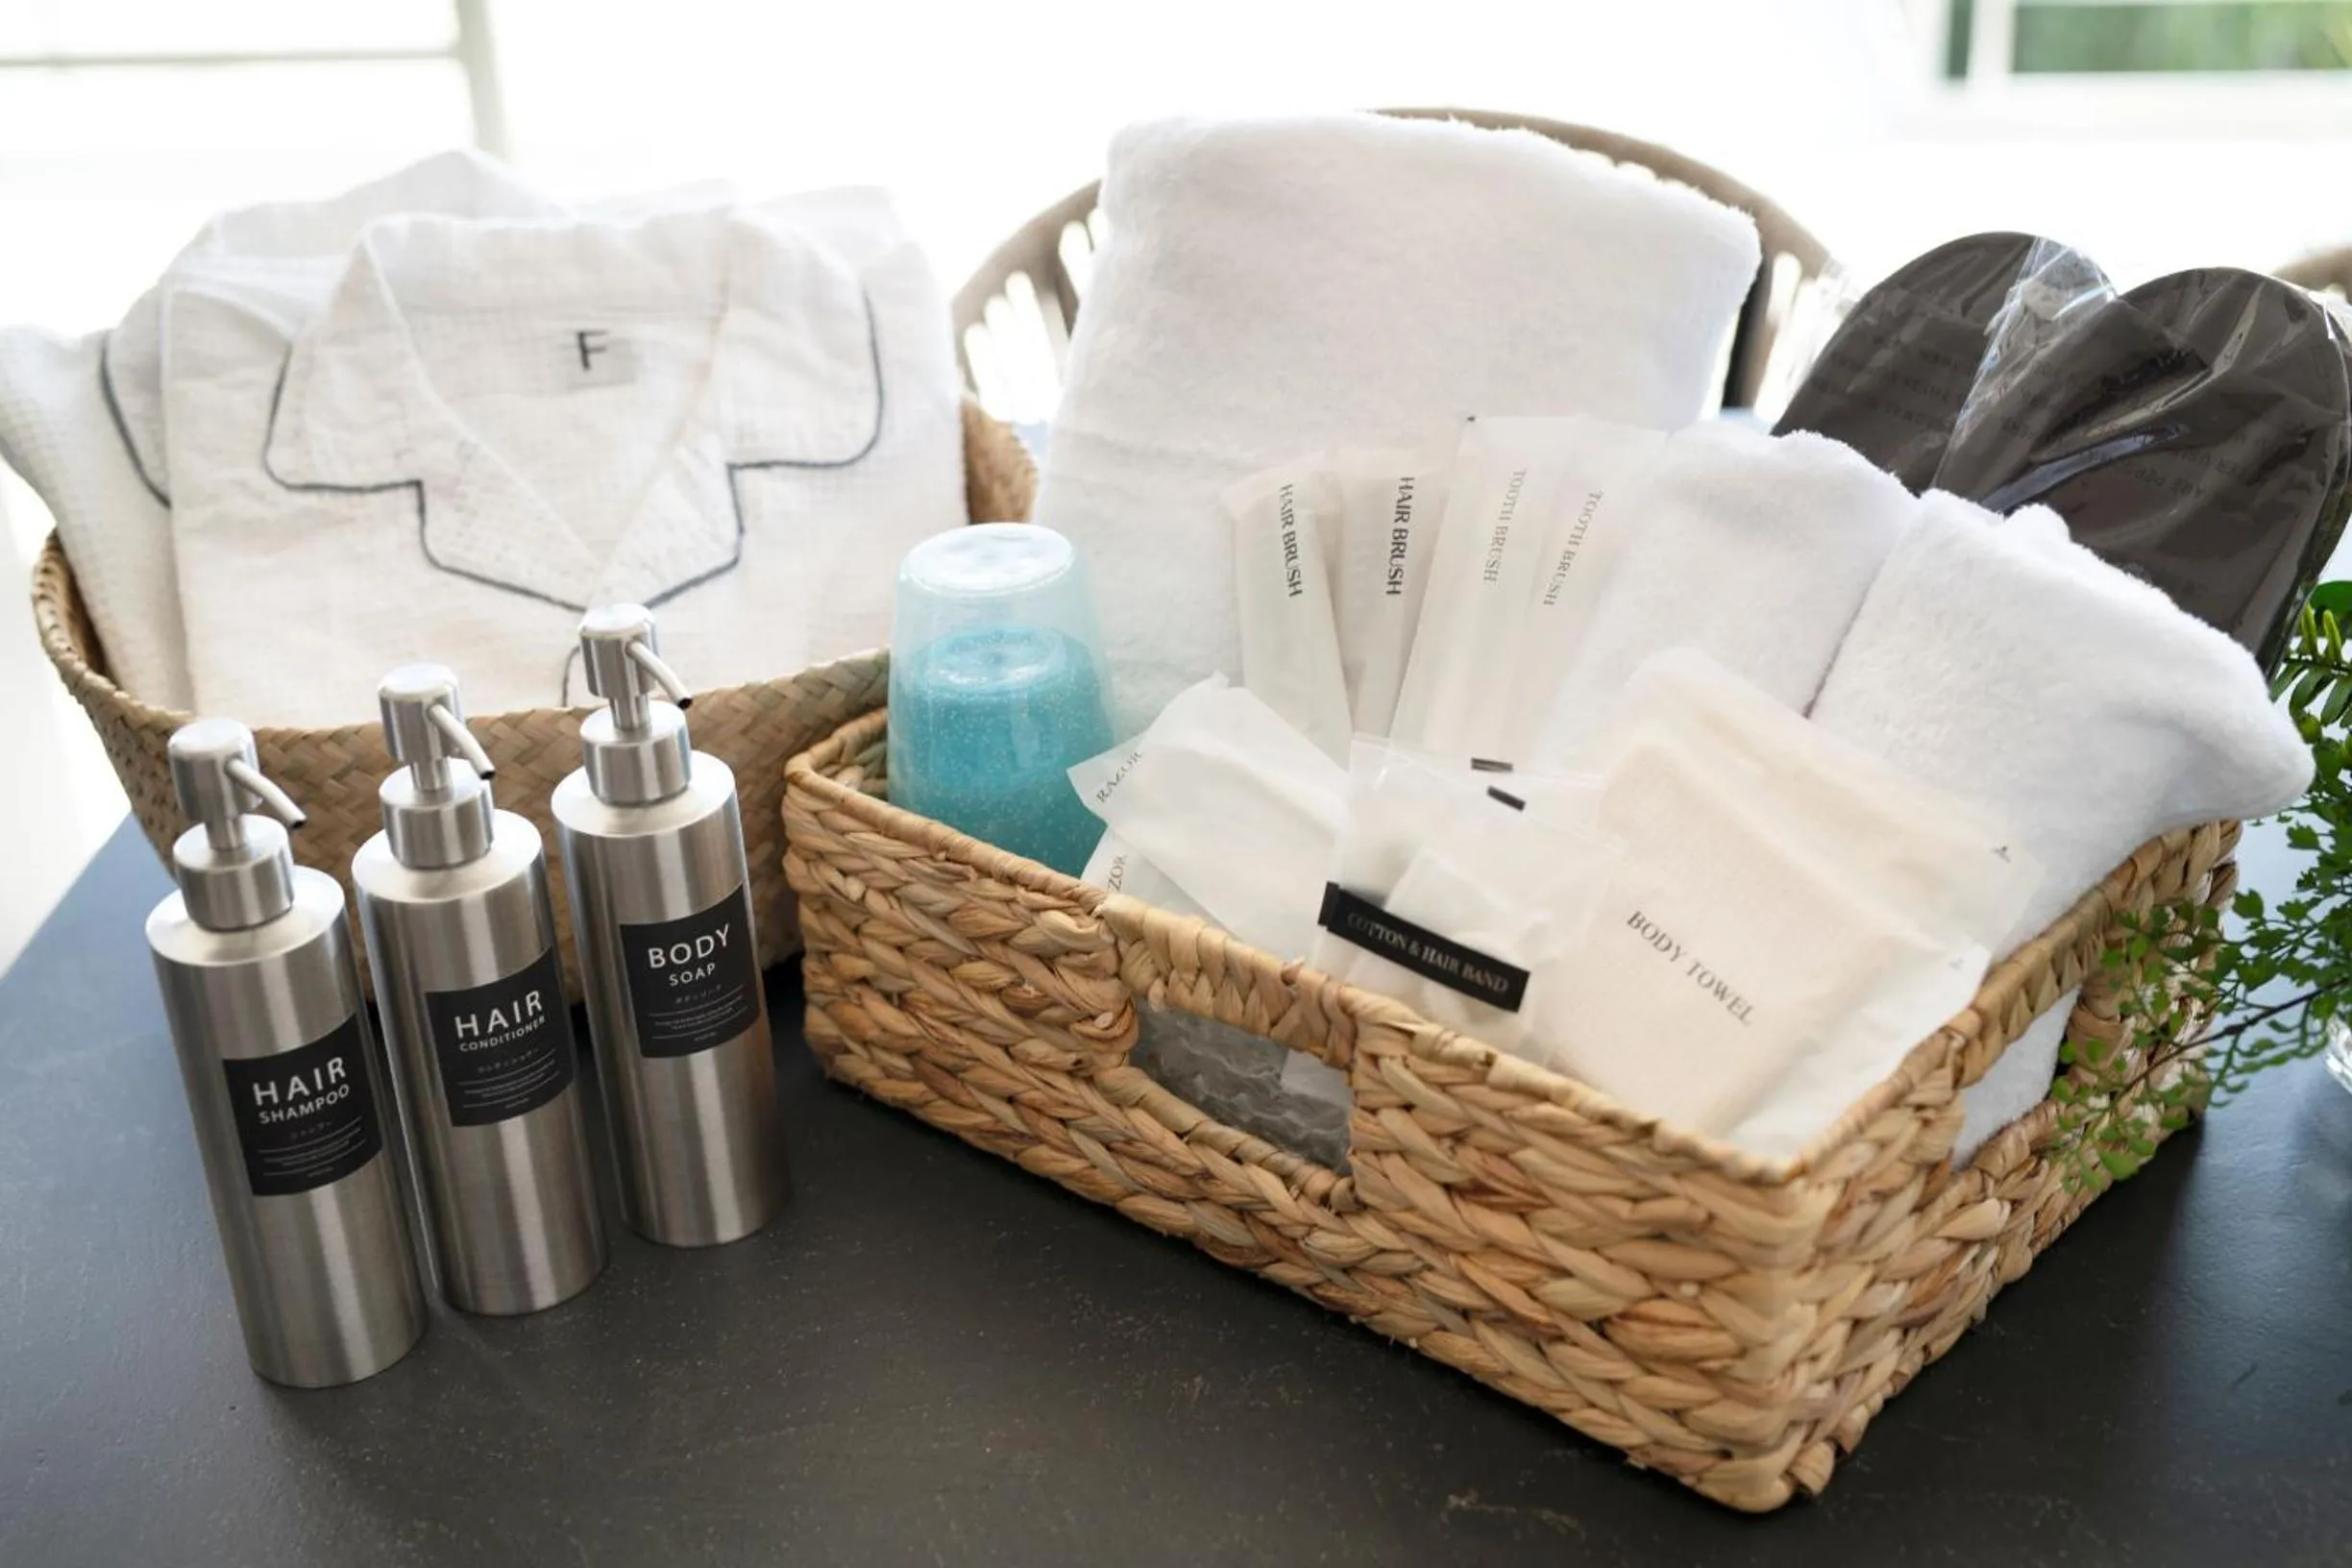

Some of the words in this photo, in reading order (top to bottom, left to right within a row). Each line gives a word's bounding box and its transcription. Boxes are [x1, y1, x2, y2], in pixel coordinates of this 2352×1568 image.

[576, 329, 609, 372] F
[1279, 483, 1294, 529] HAIR
[1393, 477, 1415, 524] HAIR
[1498, 467, 1527, 521] TOOTH
[1567, 490, 1603, 547] TOOTH
[1282, 530, 1303, 597] BRUSH
[1385, 527, 1409, 595] BRUSH
[1482, 526, 1508, 582] BRUSH
[1542, 550, 1576, 605] BRUSH
[1096, 750, 1143, 803] RAZOR
[1107, 854, 1128, 893] ZOR
[648, 922, 730, 968] BODY
[1347, 912, 1408, 950] COTTON
[1408, 940, 1421, 958] &
[1421, 944, 1459, 974] HAIR
[1462, 962, 1509, 993] BAND
[1627, 910, 1688, 963] BODY
[1686, 961, 1754, 1026] TOWEL
[669, 962, 716, 987] SOAP
[454, 991, 543, 1039] HAIR
[458, 1015, 547, 1052] CONDITIONER
[253, 1057, 347, 1106] HAIR
[258, 1083, 350, 1125] SHAMPOO
